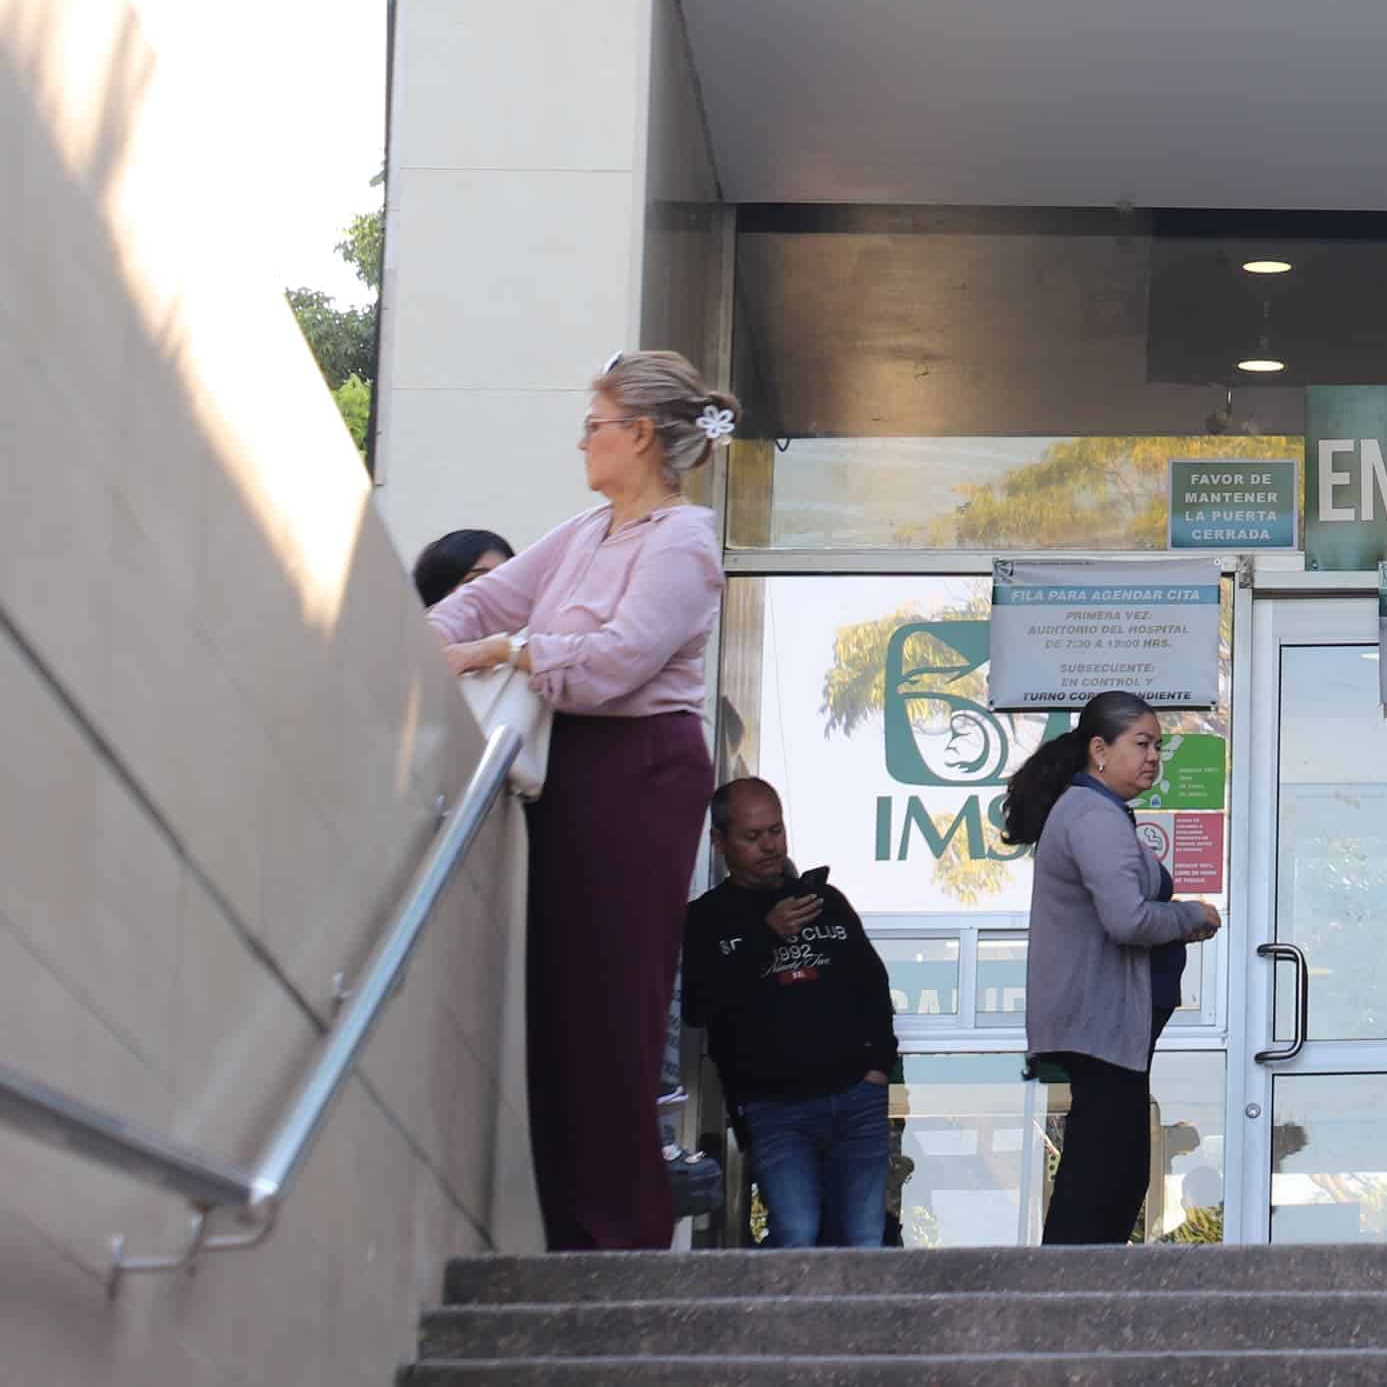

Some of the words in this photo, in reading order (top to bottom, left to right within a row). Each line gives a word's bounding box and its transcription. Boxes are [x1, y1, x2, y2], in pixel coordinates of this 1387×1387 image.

[1191, 474, 1244, 485] FAVOR
[1250, 474, 1273, 485] DE
[1184, 492, 1278, 503] MANTENER
[1184, 510, 1206, 522] LA
[1211, 510, 1278, 522] PUERTA
[1191, 528, 1272, 540] CERRADA
[1011, 589, 1045, 601] FILA
[1047, 589, 1088, 601] PARA
[1091, 589, 1163, 601] AGENDAR
[1166, 589, 1201, 601] CITA
[1065, 611, 1121, 621] PRIMERA
[1027, 624, 1098, 635] AUDITORIO
[1101, 624, 1124, 635] DEL
[1127, 624, 1190, 635] HOSPITAL
[1061, 677, 1078, 687] EN
[1081, 677, 1141, 687] CONTROL
[1144, 677, 1154, 687] Y
[1023, 691, 1066, 701] TURNO
[1069, 691, 1192, 701] CORNDIENTE
[875, 794, 1036, 862] IMS
[801, 925, 848, 941] CLUB
